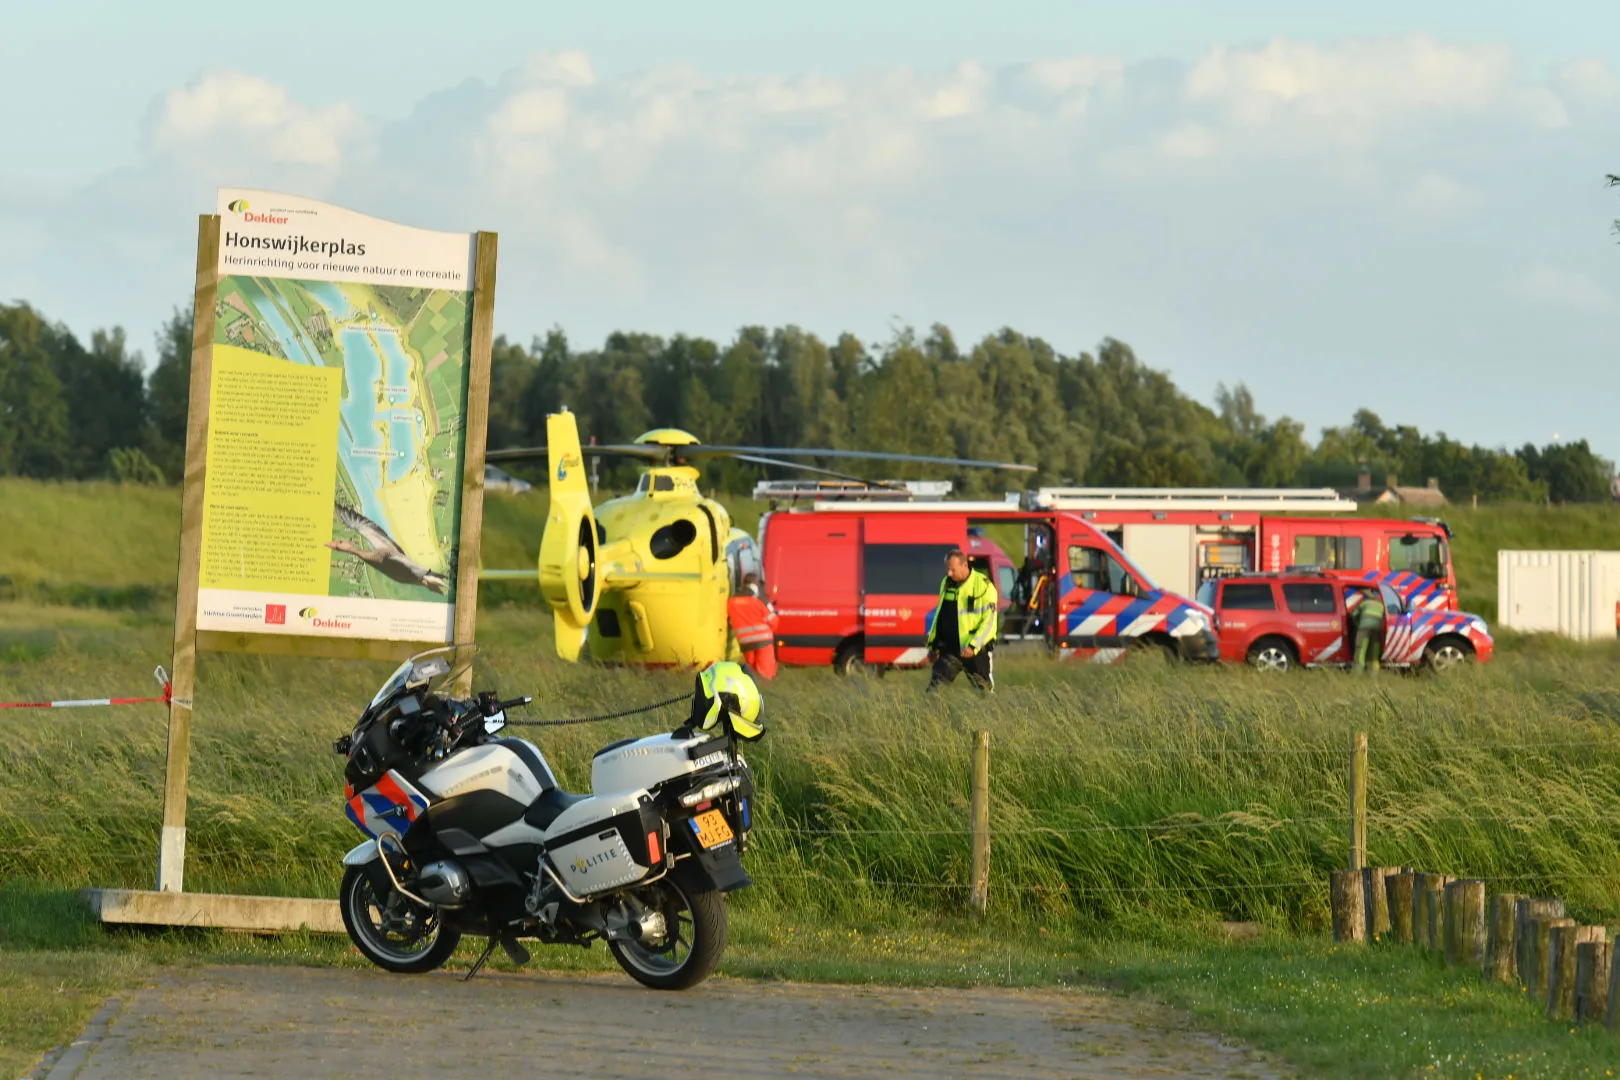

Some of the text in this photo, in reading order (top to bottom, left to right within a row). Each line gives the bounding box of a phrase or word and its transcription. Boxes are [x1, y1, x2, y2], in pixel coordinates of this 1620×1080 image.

[244, 211, 289, 224] Dekker
[225, 231, 367, 257] Honswijkerplas
[224, 255, 462, 280] Herinrichting voor nieuwe natuur en recreatie
[312, 617, 352, 629] Dekker
[702, 813, 718, 828] 93
[570, 848, 618, 874] POLITIE
